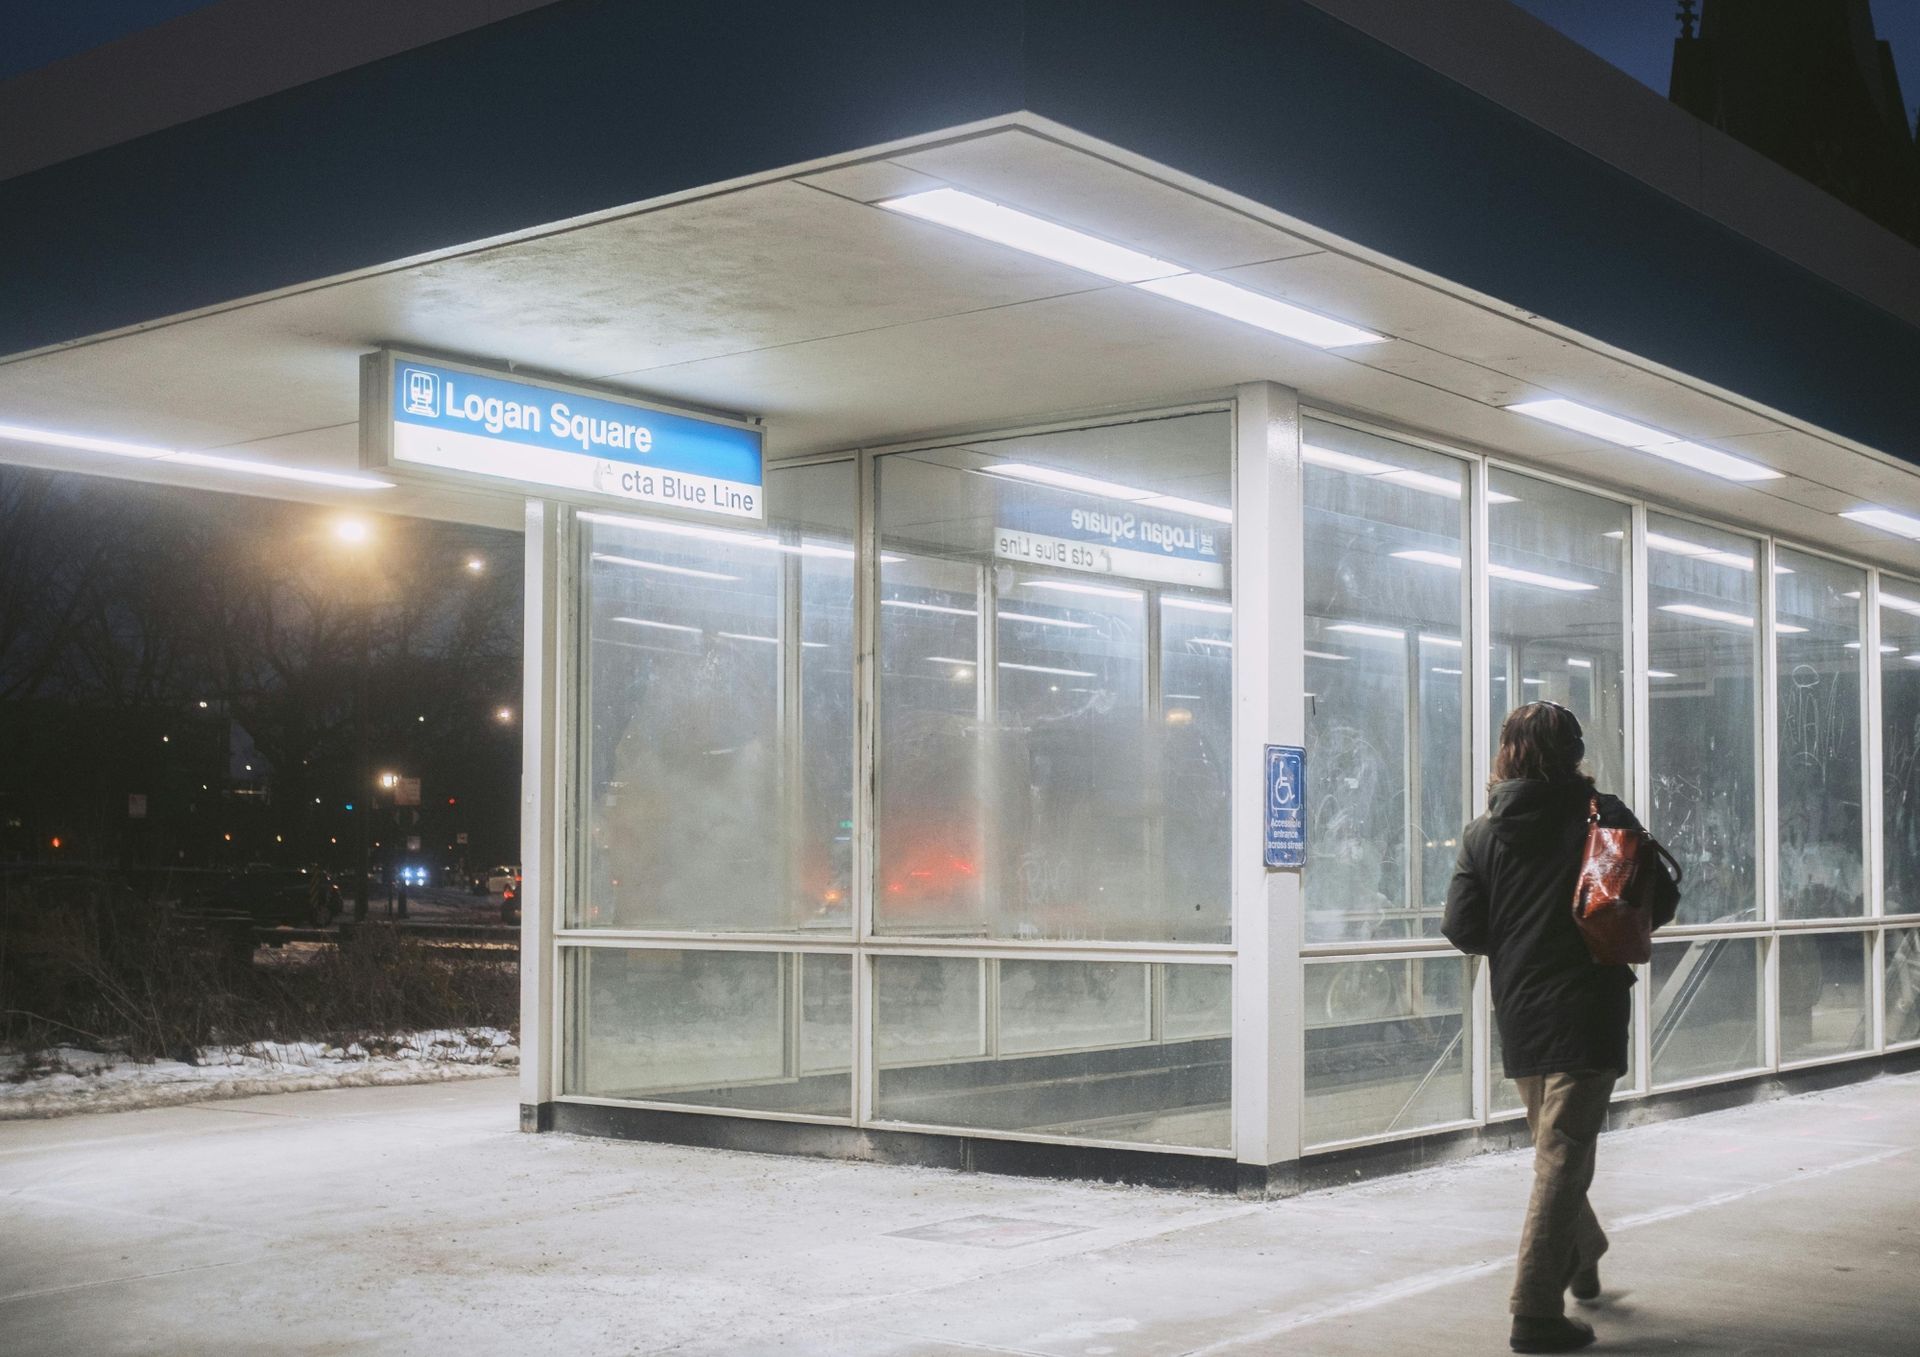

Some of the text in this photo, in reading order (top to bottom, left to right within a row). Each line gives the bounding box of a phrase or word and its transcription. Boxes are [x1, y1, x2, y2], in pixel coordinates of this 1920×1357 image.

[445, 382, 652, 453] Logan Square
[621, 470, 754, 511] cta Blue Line
